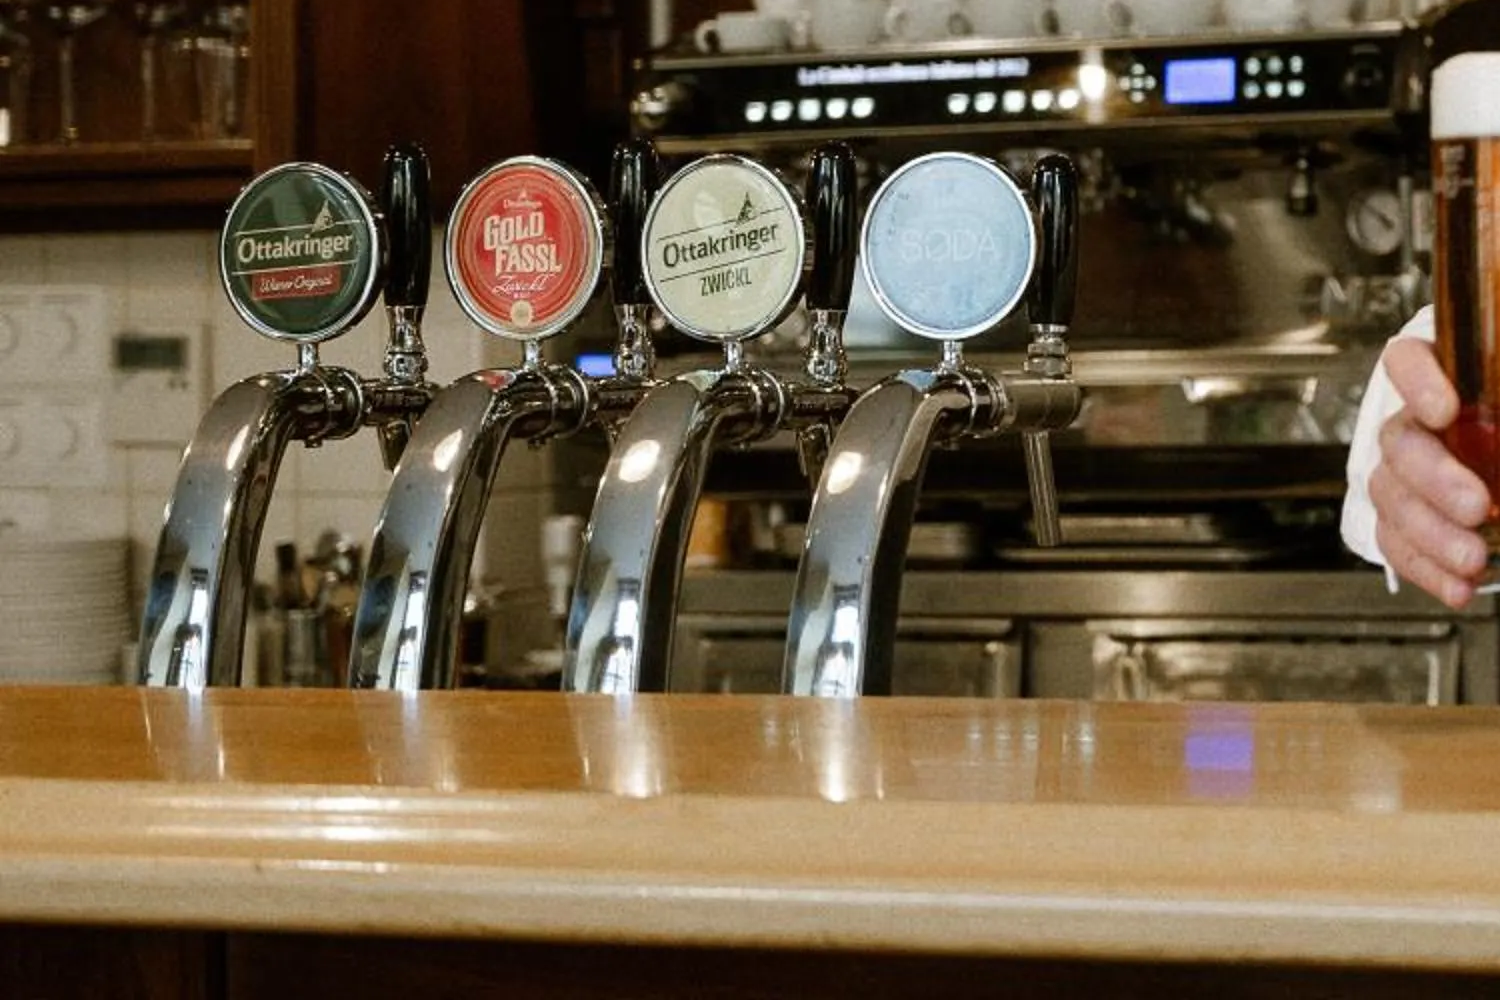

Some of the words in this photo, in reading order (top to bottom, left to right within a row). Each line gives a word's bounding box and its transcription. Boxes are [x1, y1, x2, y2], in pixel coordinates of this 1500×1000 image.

[484, 211, 545, 250] GOLD
[664, 223, 778, 268] Ottakringer
[237, 234, 353, 263] Ottakringer
[495, 243, 563, 277] FASSL
[700, 267, 752, 296] ZWICKL
